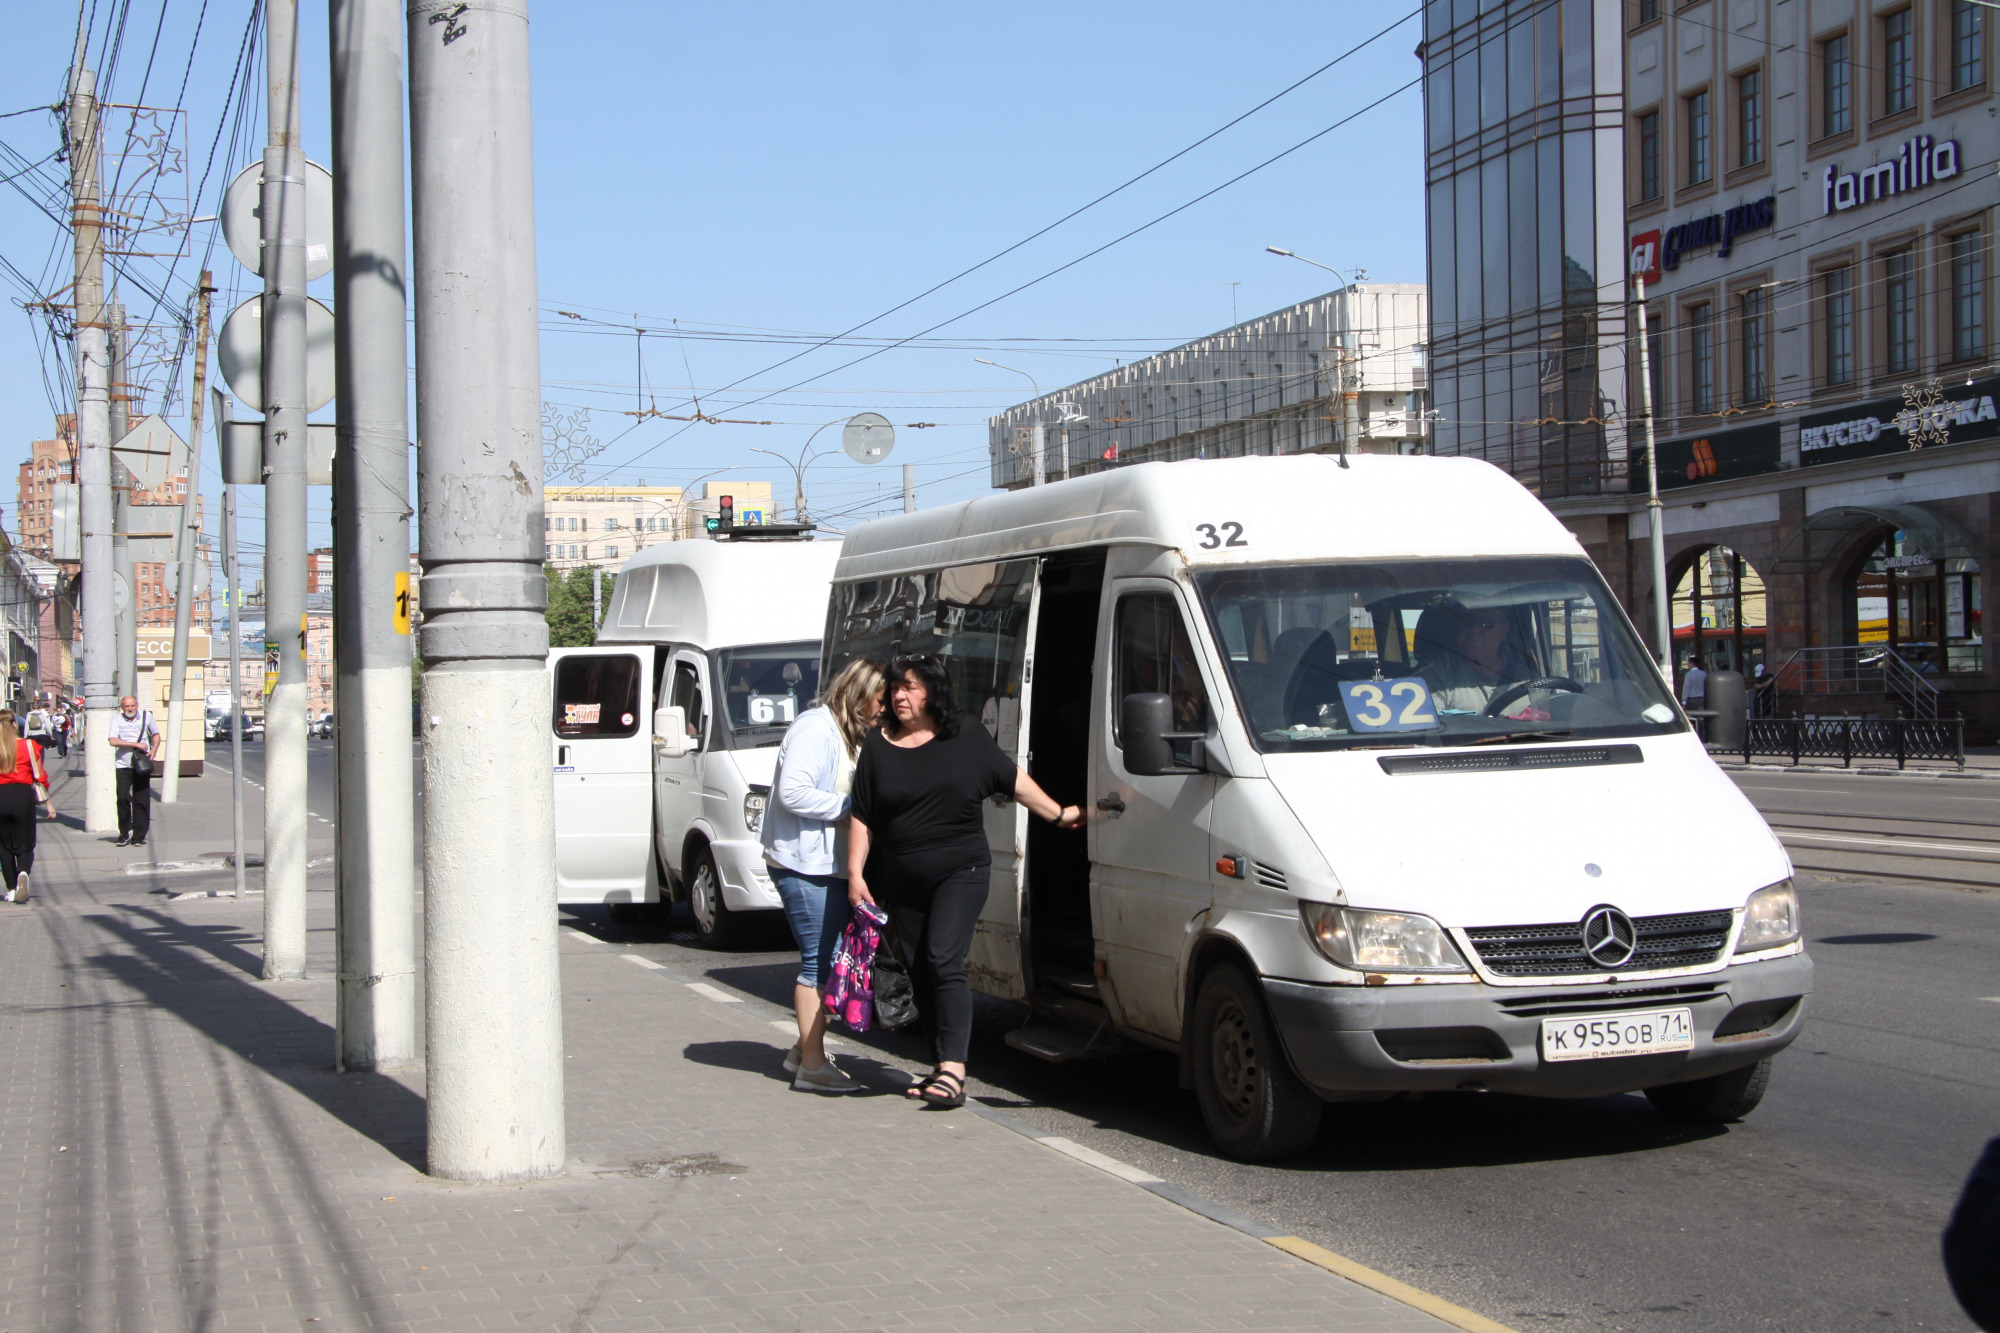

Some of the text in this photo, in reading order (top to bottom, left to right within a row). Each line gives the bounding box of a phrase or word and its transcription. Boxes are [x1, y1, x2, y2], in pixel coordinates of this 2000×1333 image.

[1822, 134, 1961, 216] familia
[1663, 196, 1776, 272] GLORIA JEANS
[1800, 416, 1881, 452] ВКУСНО
[1195, 520, 1249, 550] 32
[575, 710, 600, 723] ТУЛА
[751, 697, 795, 723] 61
[1349, 681, 1435, 727] 32
[1660, 1014, 1683, 1034] 71
[1660, 1034, 1678, 1042] RUS
